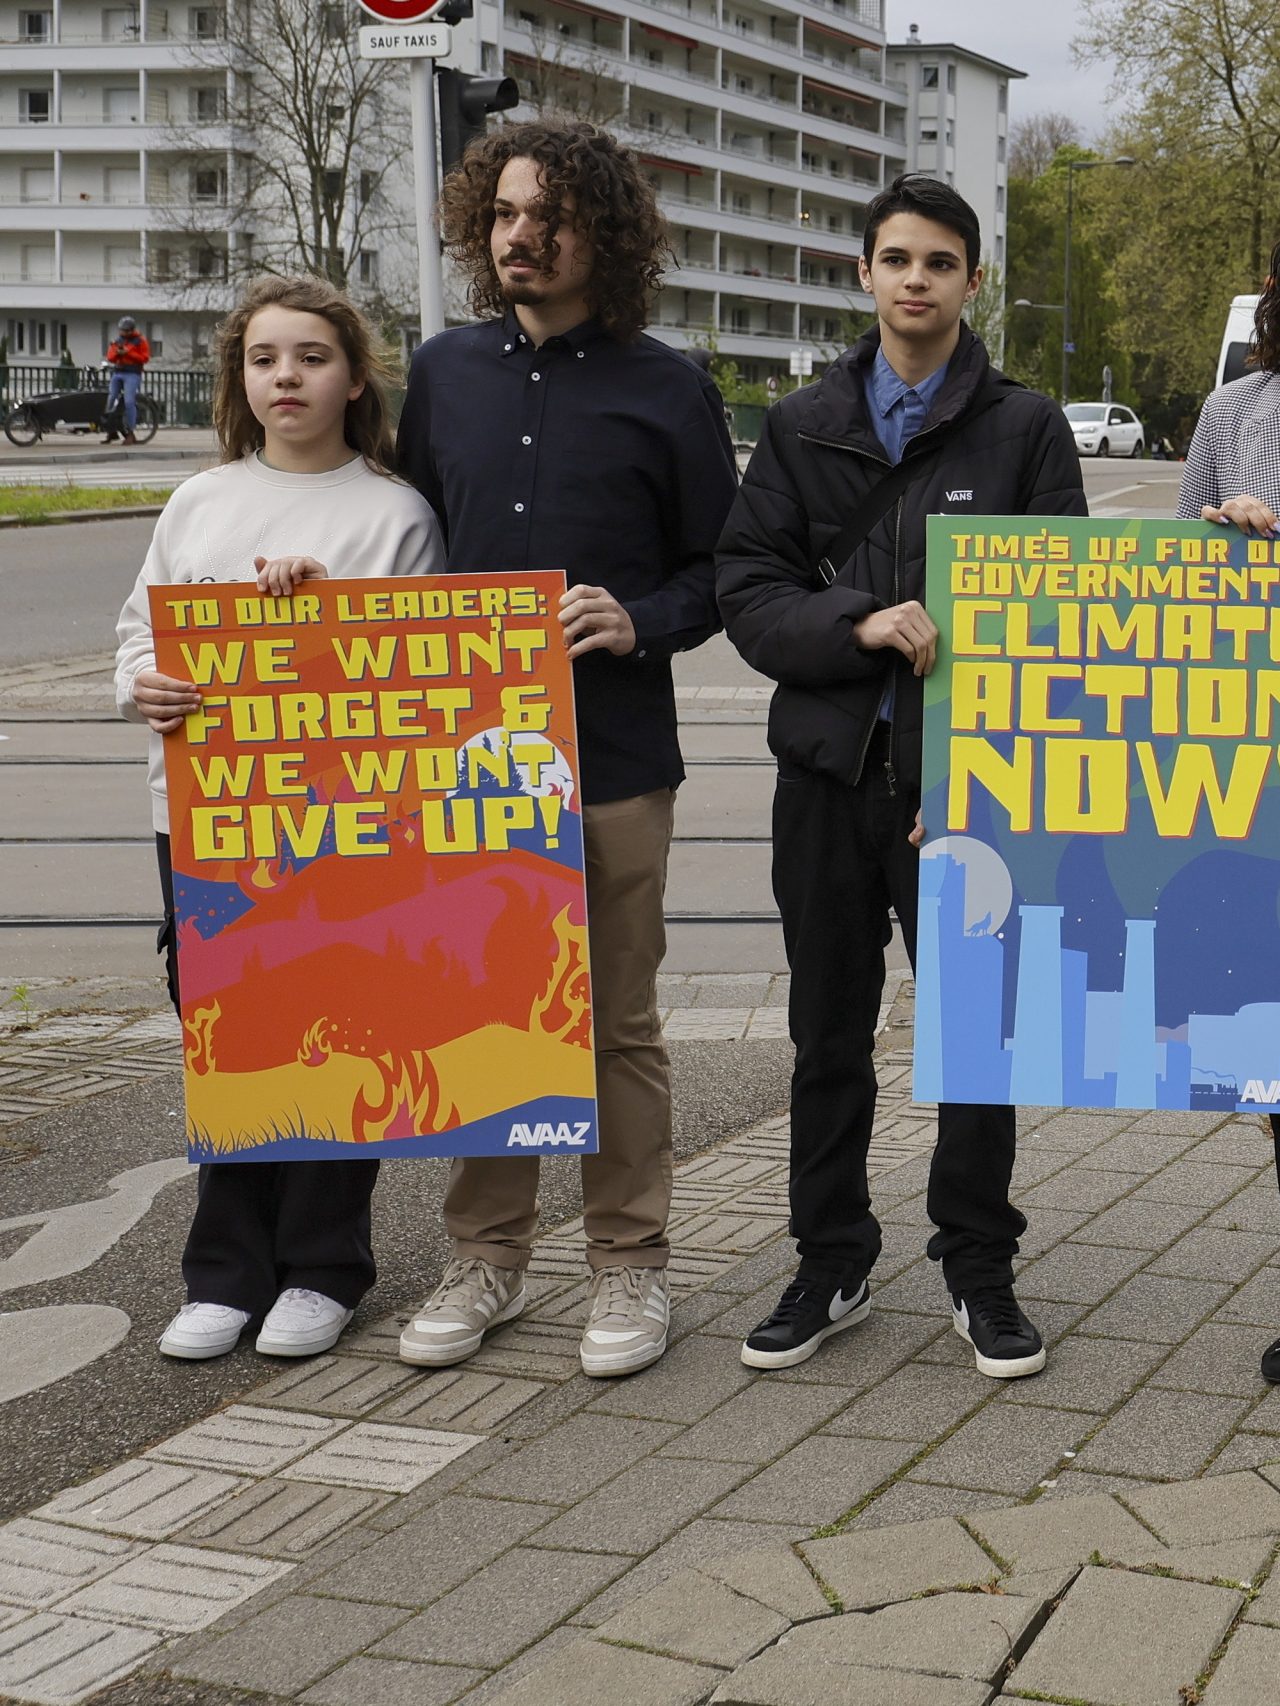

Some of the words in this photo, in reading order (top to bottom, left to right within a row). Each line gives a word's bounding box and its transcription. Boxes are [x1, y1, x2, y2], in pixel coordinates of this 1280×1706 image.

[370, 36, 400, 48] SAUF
[404, 35, 437, 47] TAXIS
[945, 490, 973, 501] VANS
[951, 528, 1071, 561] TIME'S
[1088, 537, 1138, 563] UP
[1156, 538, 1229, 564] FOR
[166, 598, 220, 628] TO
[235, 594, 322, 626] OUR
[337, 587, 548, 623] LEADERS:
[179, 638, 299, 685] WE
[331, 617, 547, 680] WON'T
[185, 687, 473, 744] FORGET
[501, 684, 552, 733] &
[190, 752, 308, 798] WE
[341, 731, 555, 793] WON'T
[191, 801, 391, 860] GIVE
[421, 795, 562, 855] UP!
[506, 1122, 591, 1147] AVAAZ
